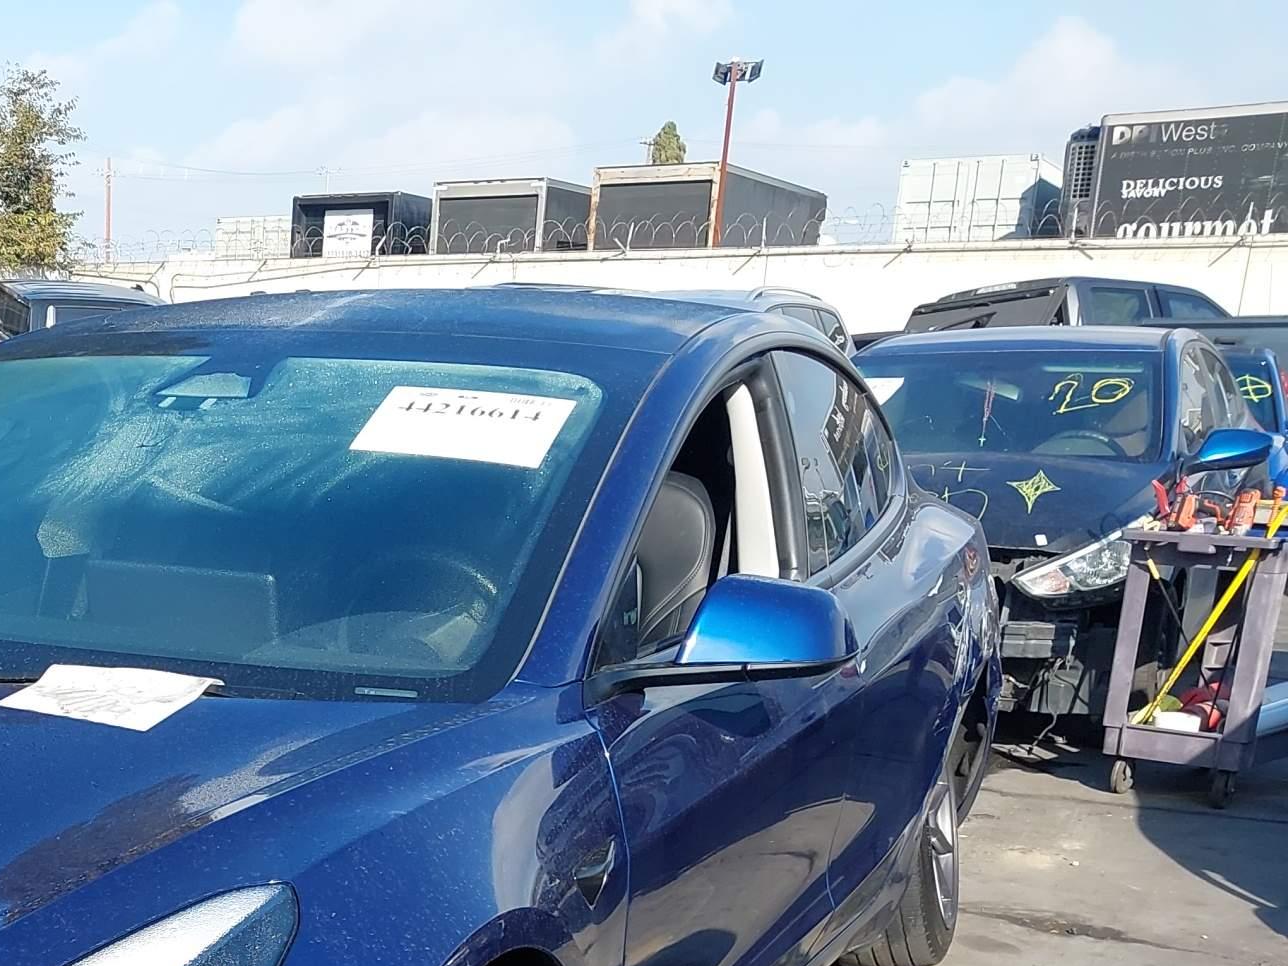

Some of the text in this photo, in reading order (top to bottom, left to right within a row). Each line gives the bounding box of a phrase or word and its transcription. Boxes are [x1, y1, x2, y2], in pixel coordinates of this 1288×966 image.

[1162, 121, 1217, 142] West
[1121, 175, 1223, 191] DELICIOUS
[398, 401, 542, 421] 44216614
